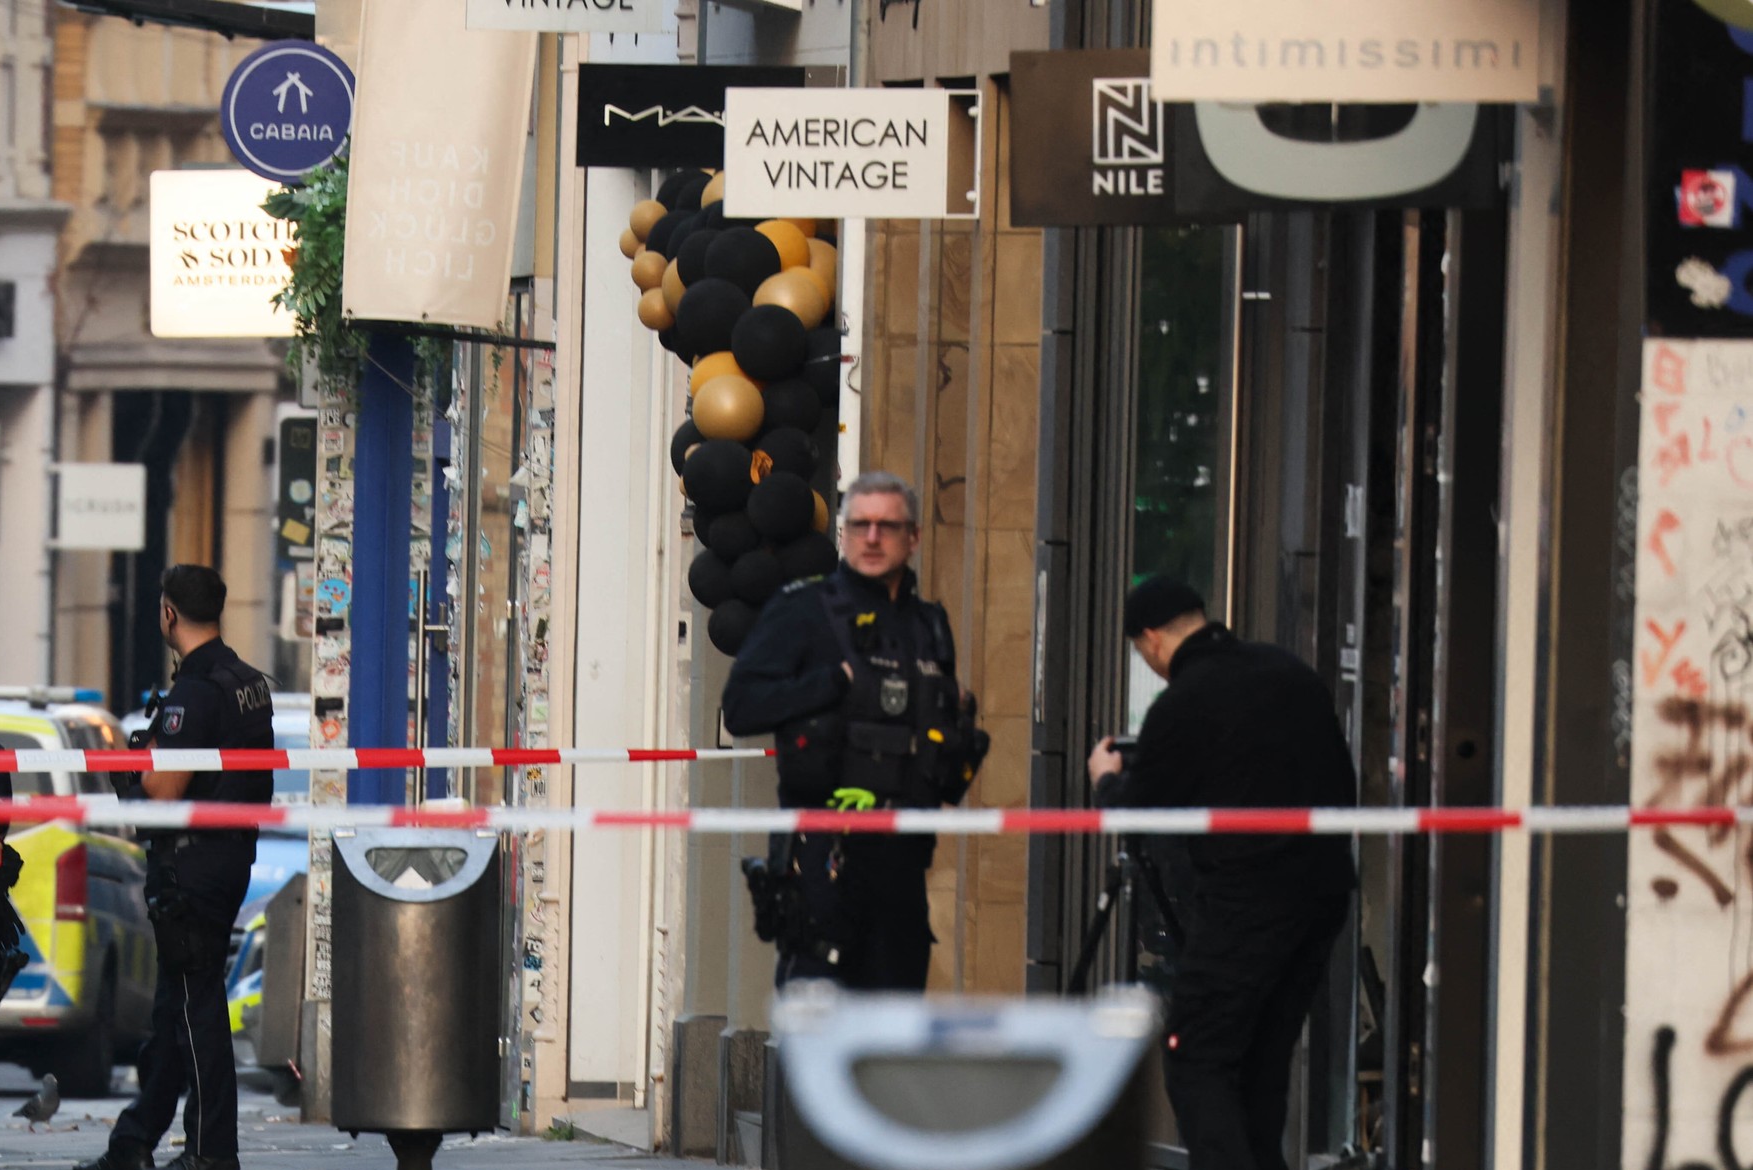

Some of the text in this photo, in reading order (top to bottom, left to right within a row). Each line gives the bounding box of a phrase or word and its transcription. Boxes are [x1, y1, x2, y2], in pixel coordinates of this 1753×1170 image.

[1171, 33, 1522, 69] intimissimi
[250, 121, 334, 142] CABAIA
[745, 118, 928, 148] AMERICAN
[763, 160, 908, 189] VINTAGE
[1092, 168, 1164, 195] NILE
[210, 248, 276, 268] SOD
